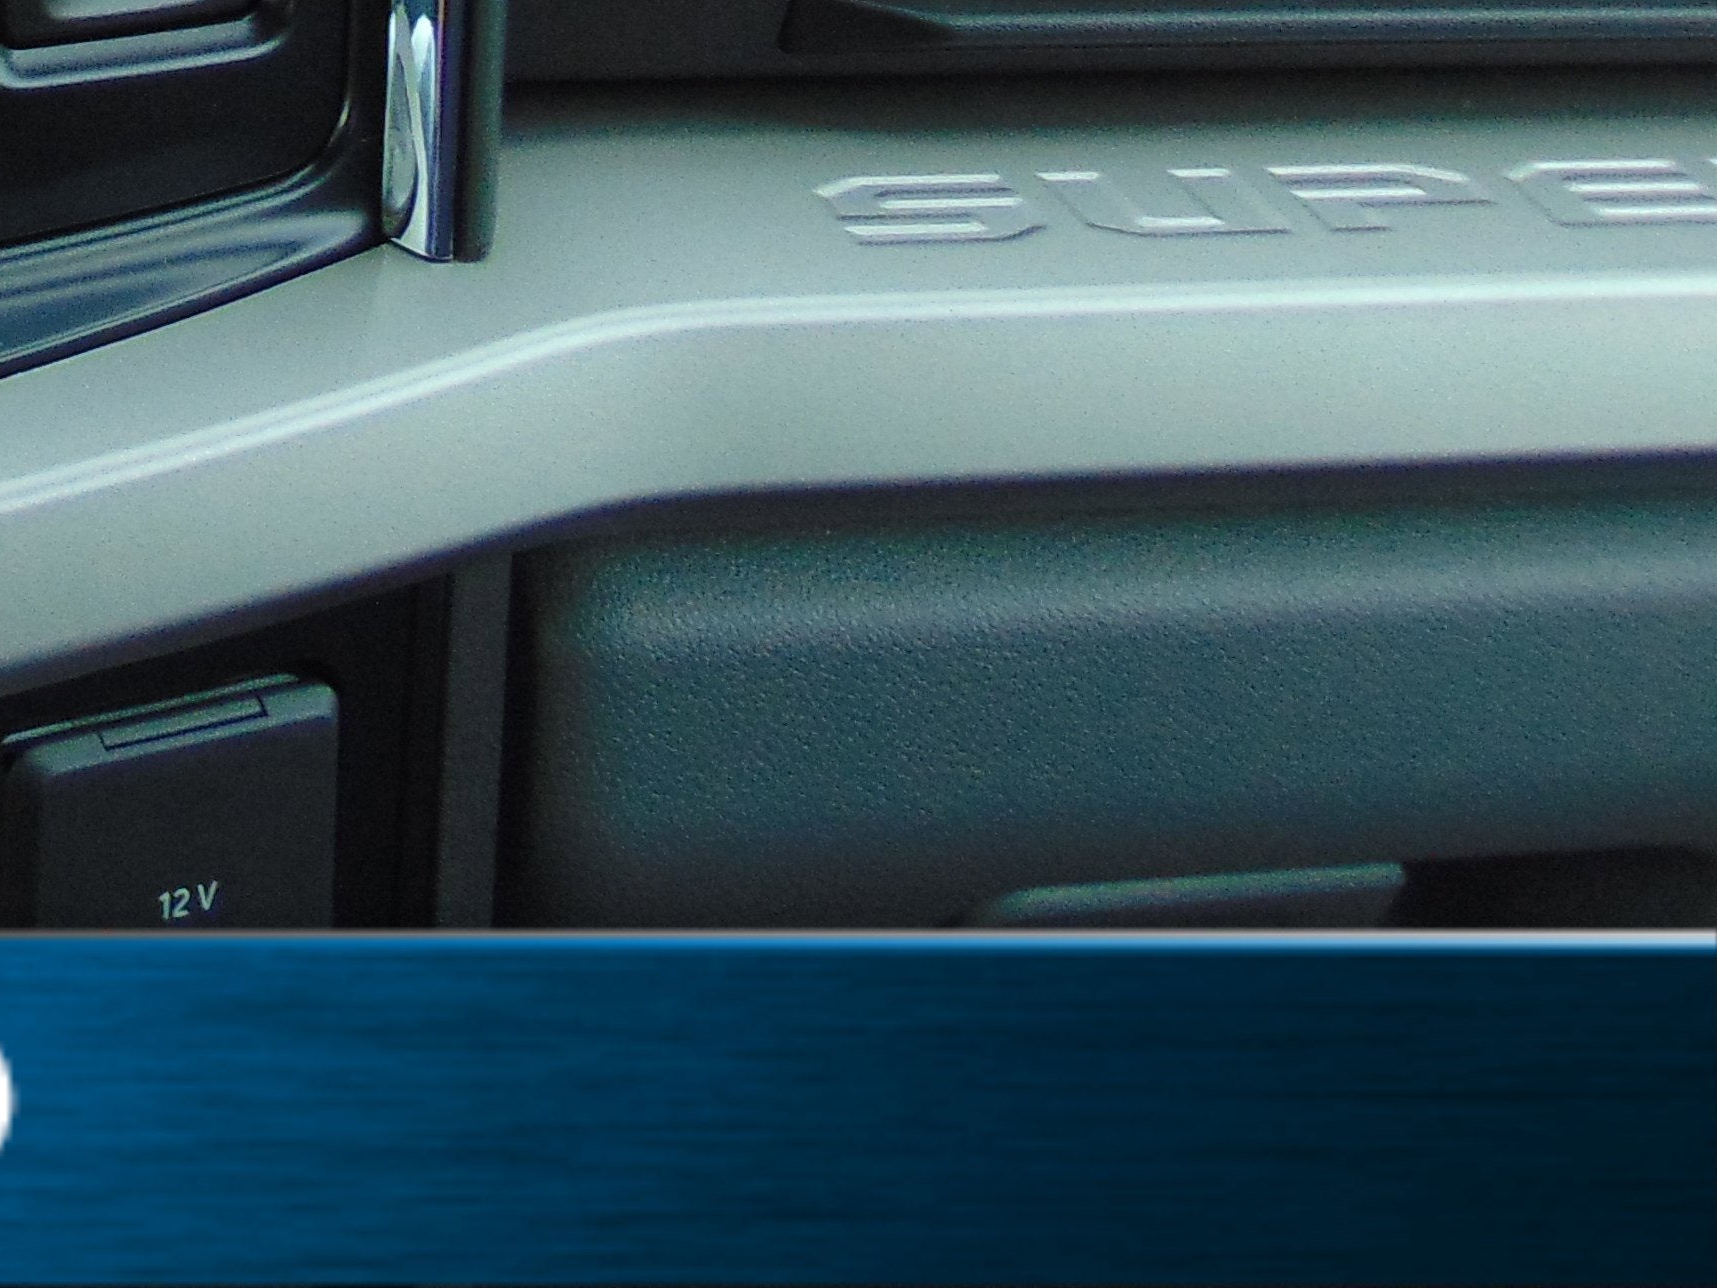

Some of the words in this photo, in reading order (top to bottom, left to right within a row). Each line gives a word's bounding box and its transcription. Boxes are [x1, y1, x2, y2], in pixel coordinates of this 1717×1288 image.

[813, 158, 1717, 247] SUPE
[158, 886, 191, 921] 12
[196, 879, 220, 912] V
